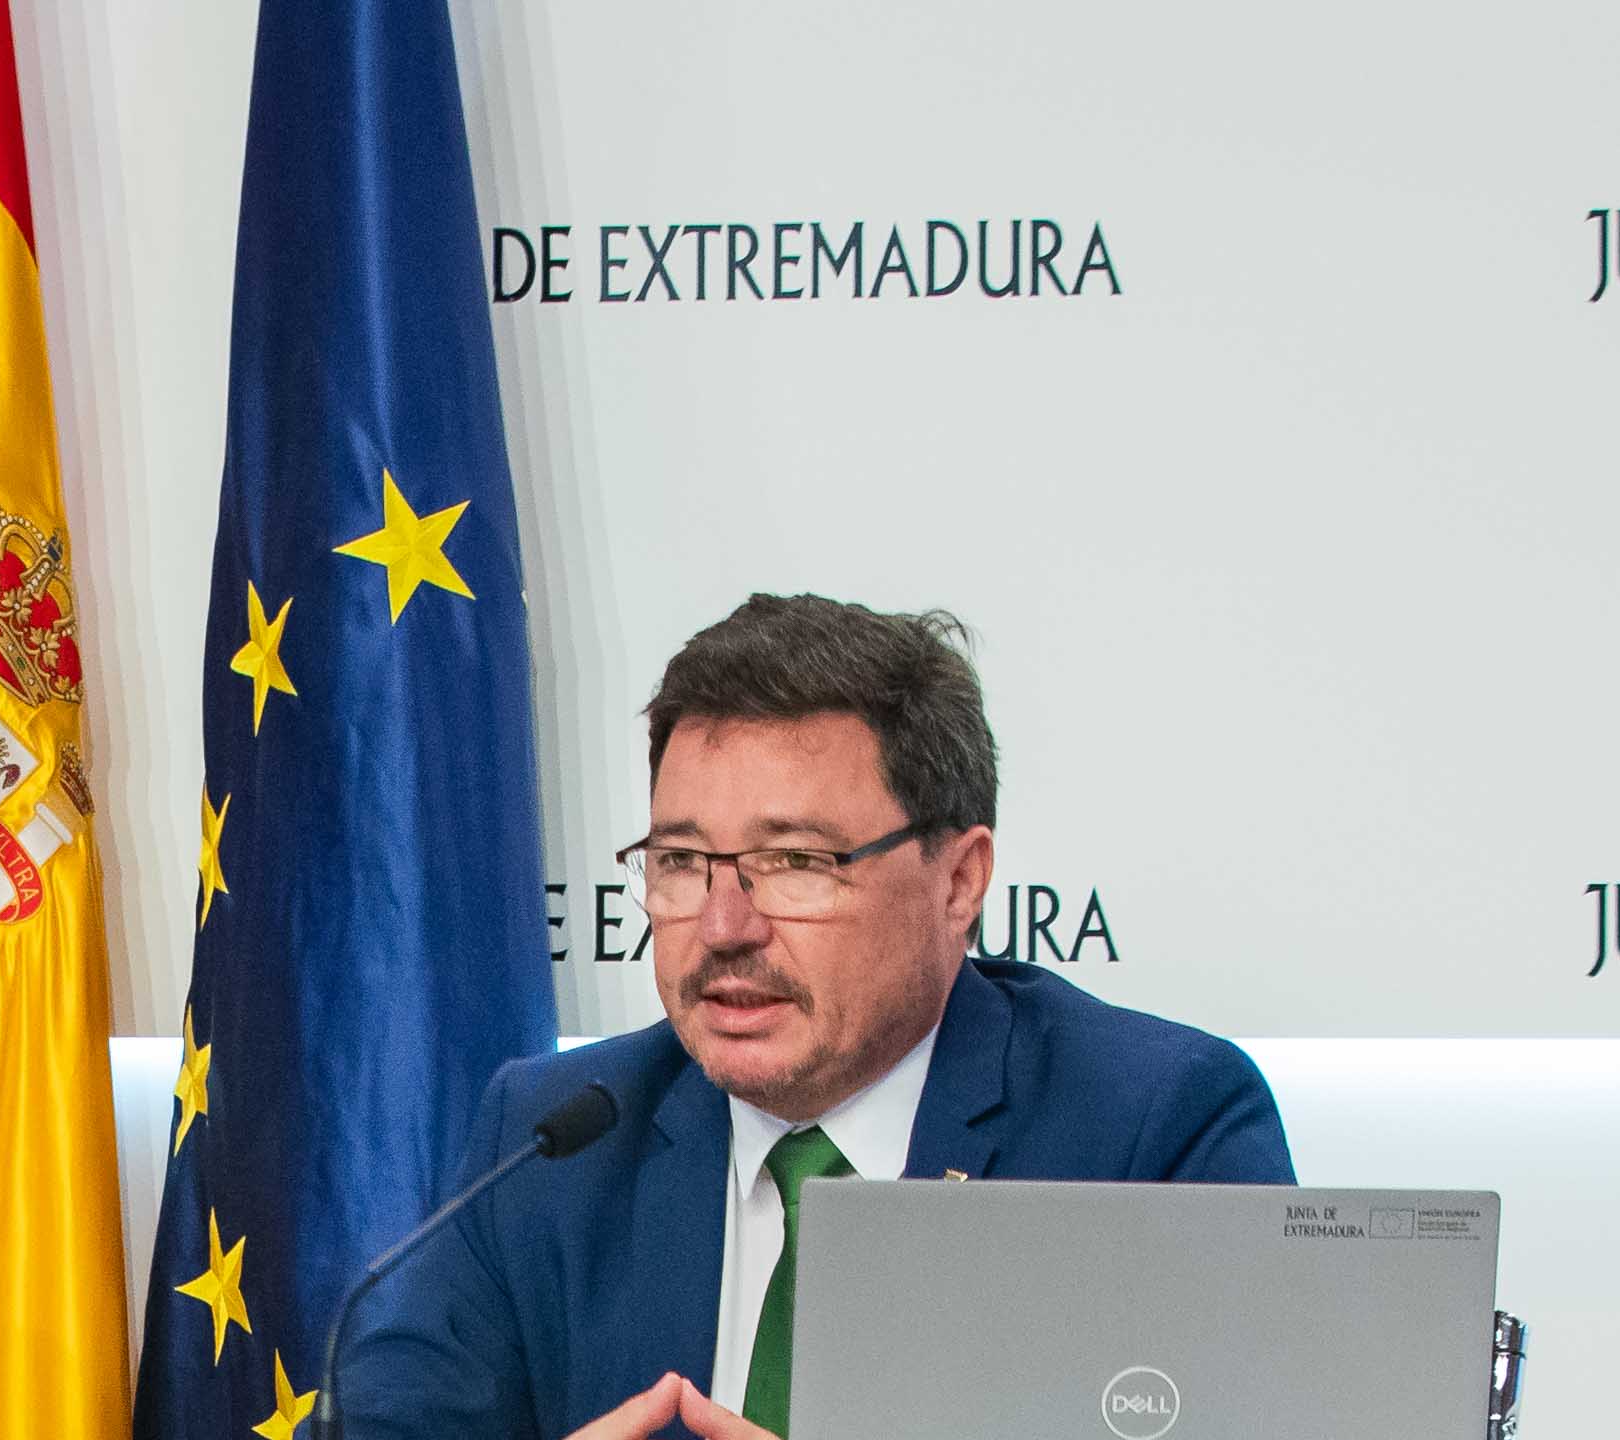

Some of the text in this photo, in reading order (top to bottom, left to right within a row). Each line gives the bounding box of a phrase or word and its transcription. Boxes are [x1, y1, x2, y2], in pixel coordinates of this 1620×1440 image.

[493, 220, 1122, 304] DE EXTREMADURA
[1284, 1224, 1365, 1238] EXTREMADURA
[1112, 1394, 1171, 1414] DELL
